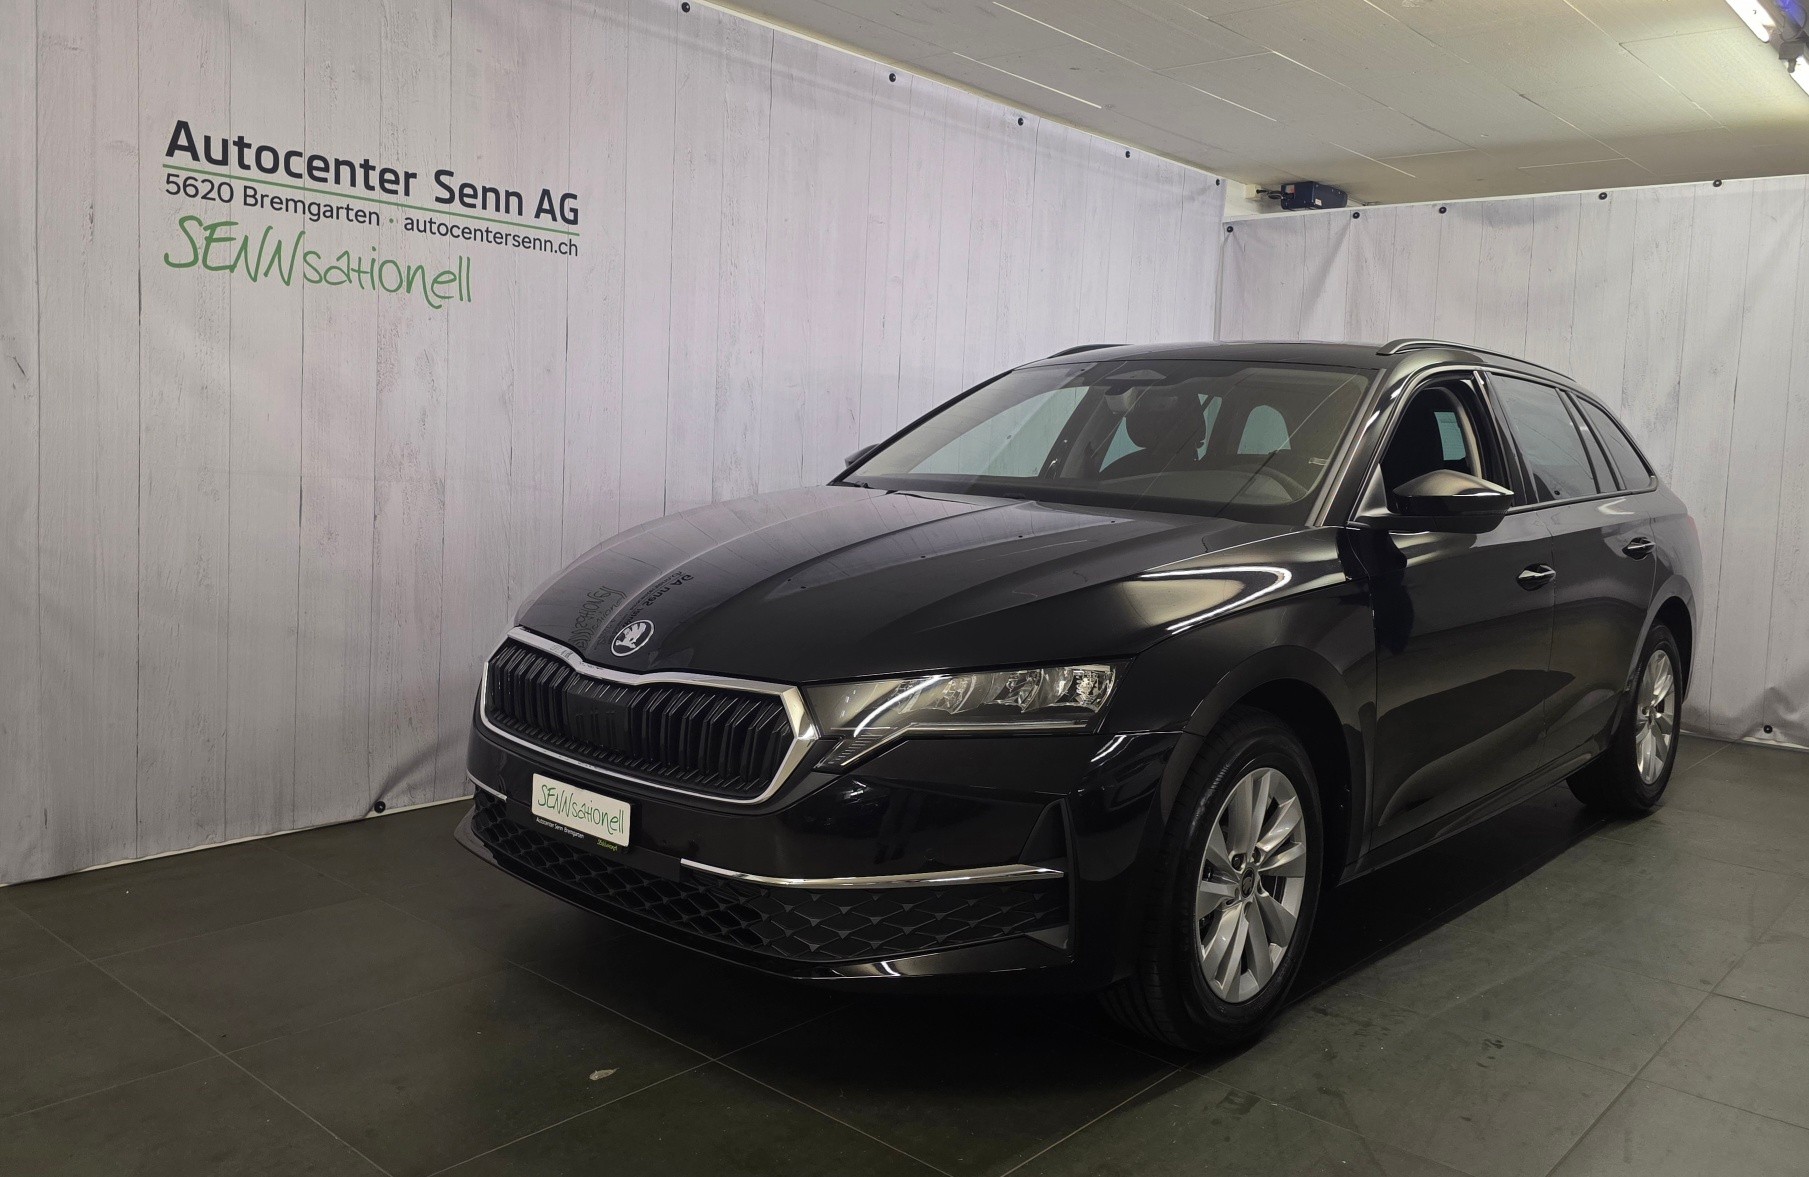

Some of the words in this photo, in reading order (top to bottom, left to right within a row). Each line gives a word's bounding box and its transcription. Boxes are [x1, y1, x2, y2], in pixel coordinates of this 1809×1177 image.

[165, 119, 417, 197] Autocenter
[434, 169, 524, 217] Senn
[534, 188, 580, 226] AG
[165, 173, 234, 203] 5620
[243, 185, 381, 226] Bremgarten
[403, 214, 579, 257] autocentersenn.ch
[163, 215, 473, 309] SENNsationell
[537, 784, 624, 835] SENNsationell
